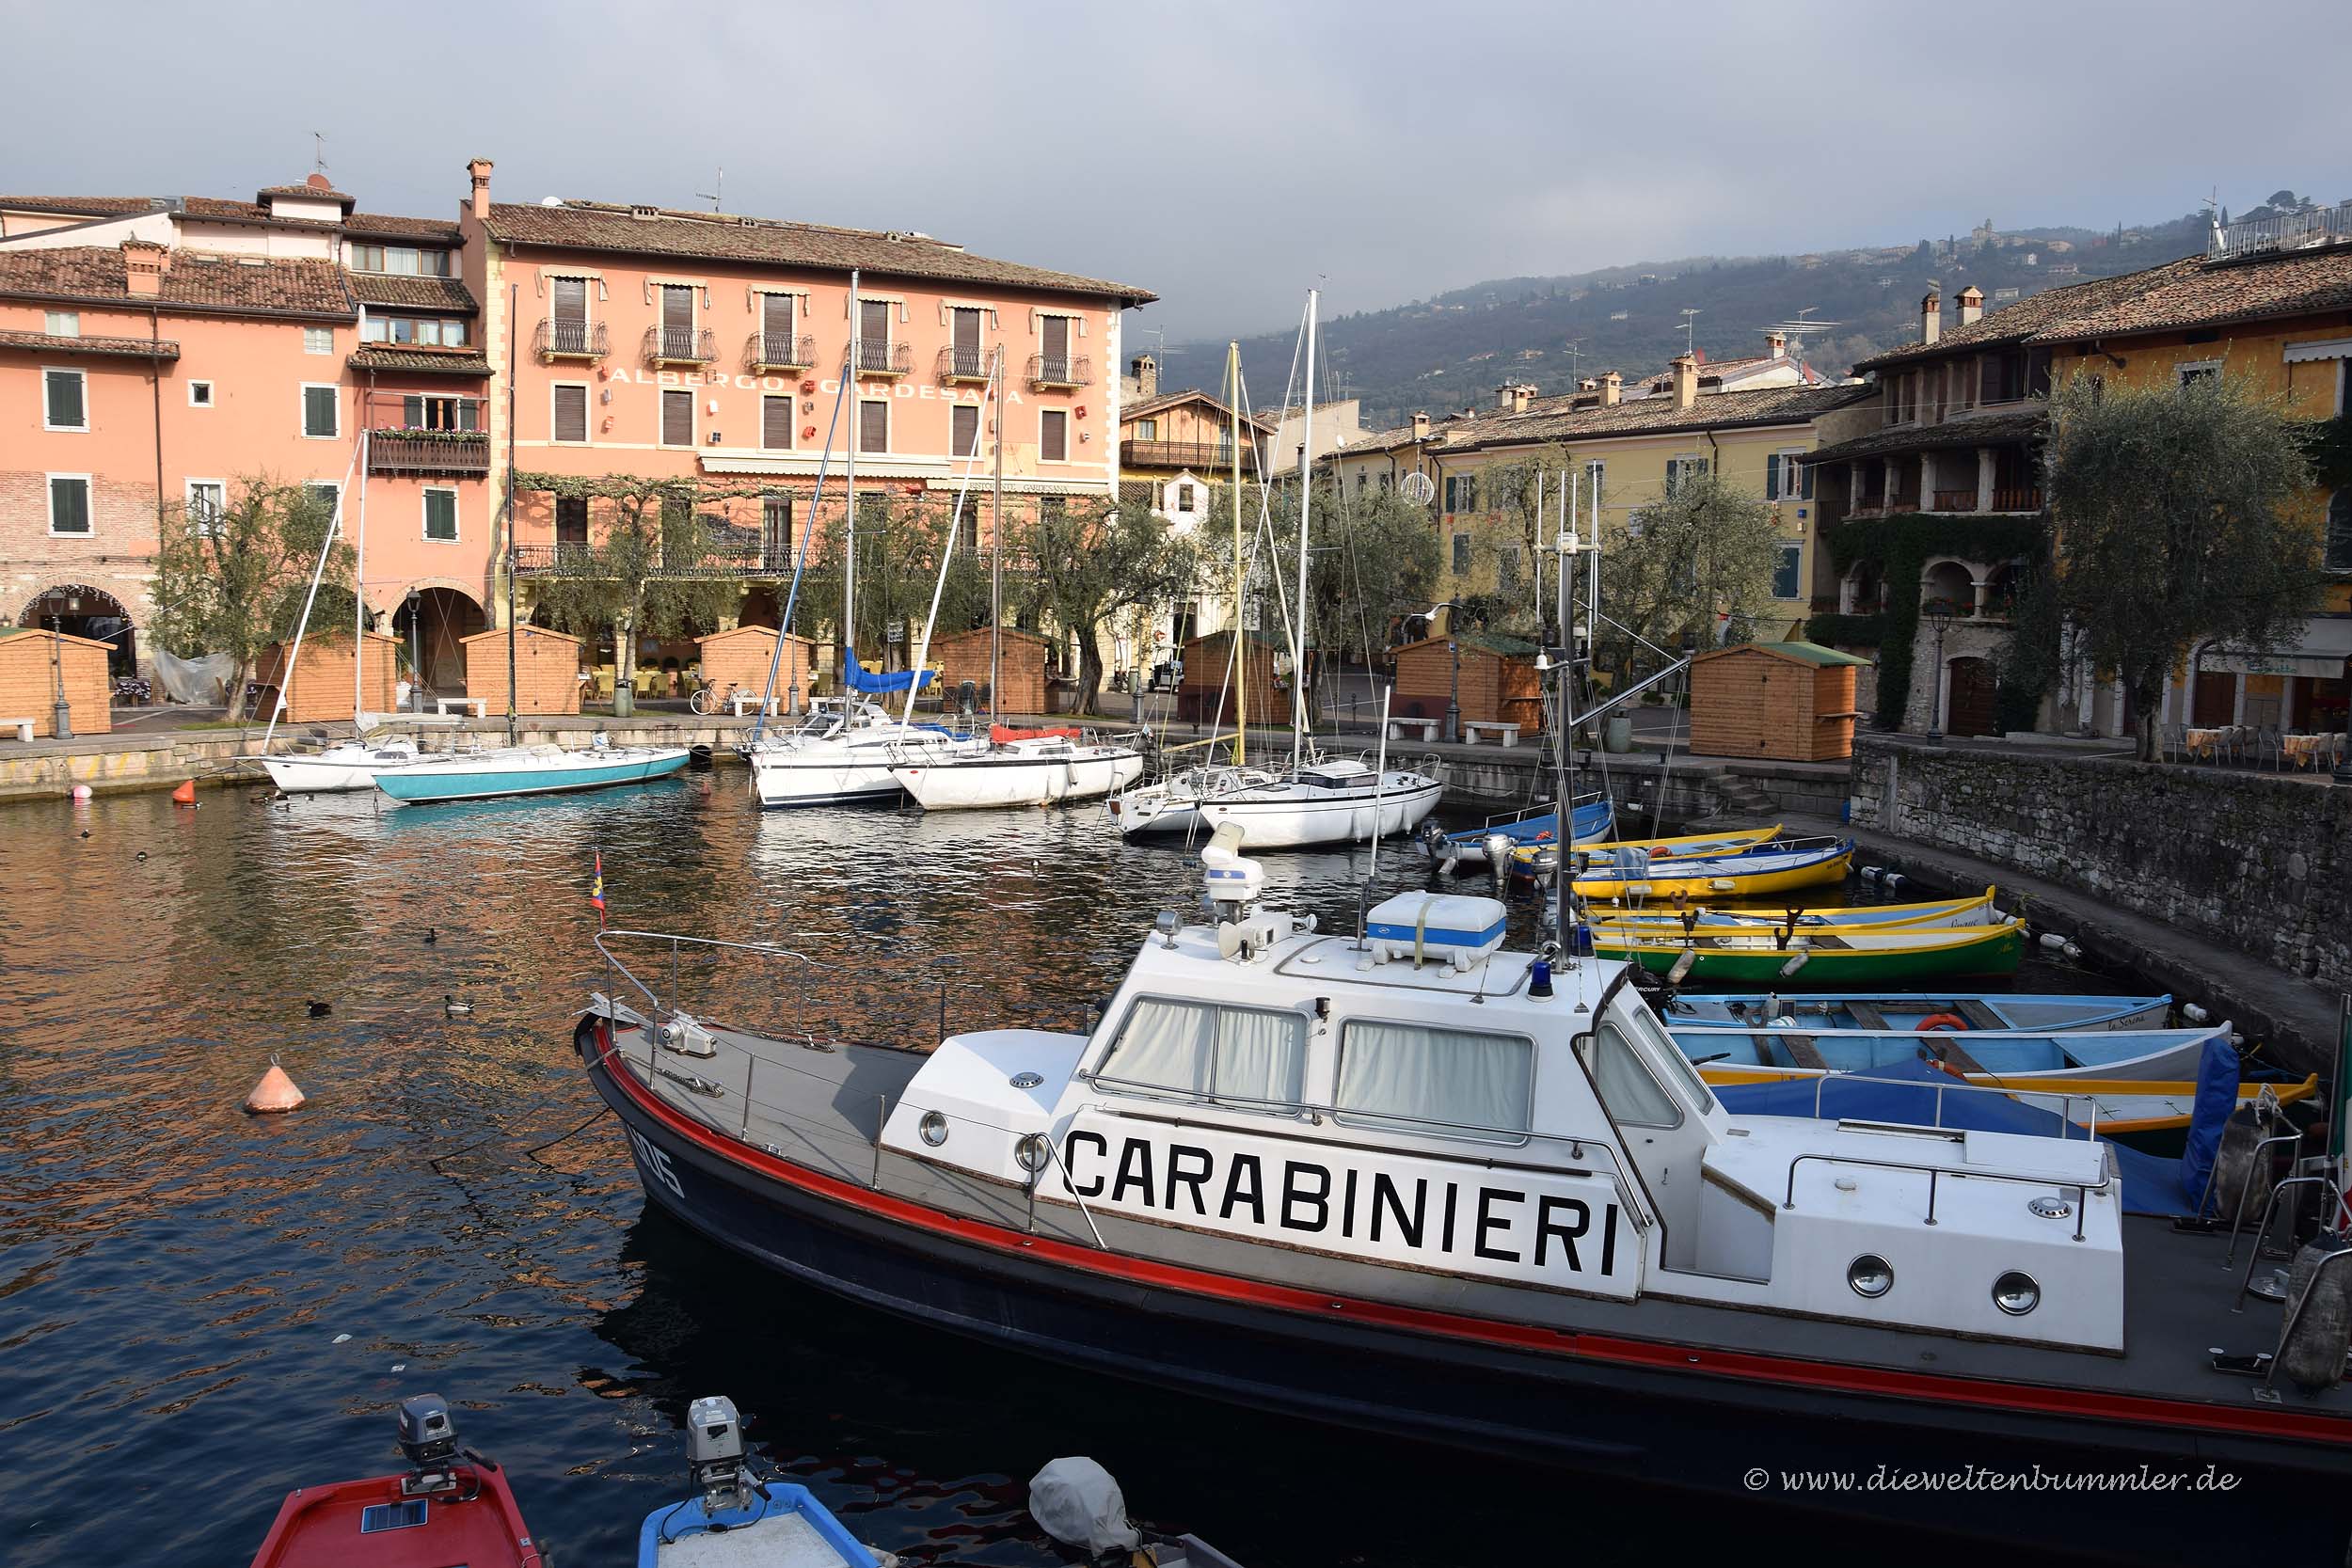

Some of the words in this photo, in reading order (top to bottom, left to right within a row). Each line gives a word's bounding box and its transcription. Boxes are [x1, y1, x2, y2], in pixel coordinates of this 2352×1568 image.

[610, 368, 785, 390] ALBERGO
[819, 379, 1024, 404] GARDESAA
[1064, 1129, 1619, 1276] CARABINIERI
